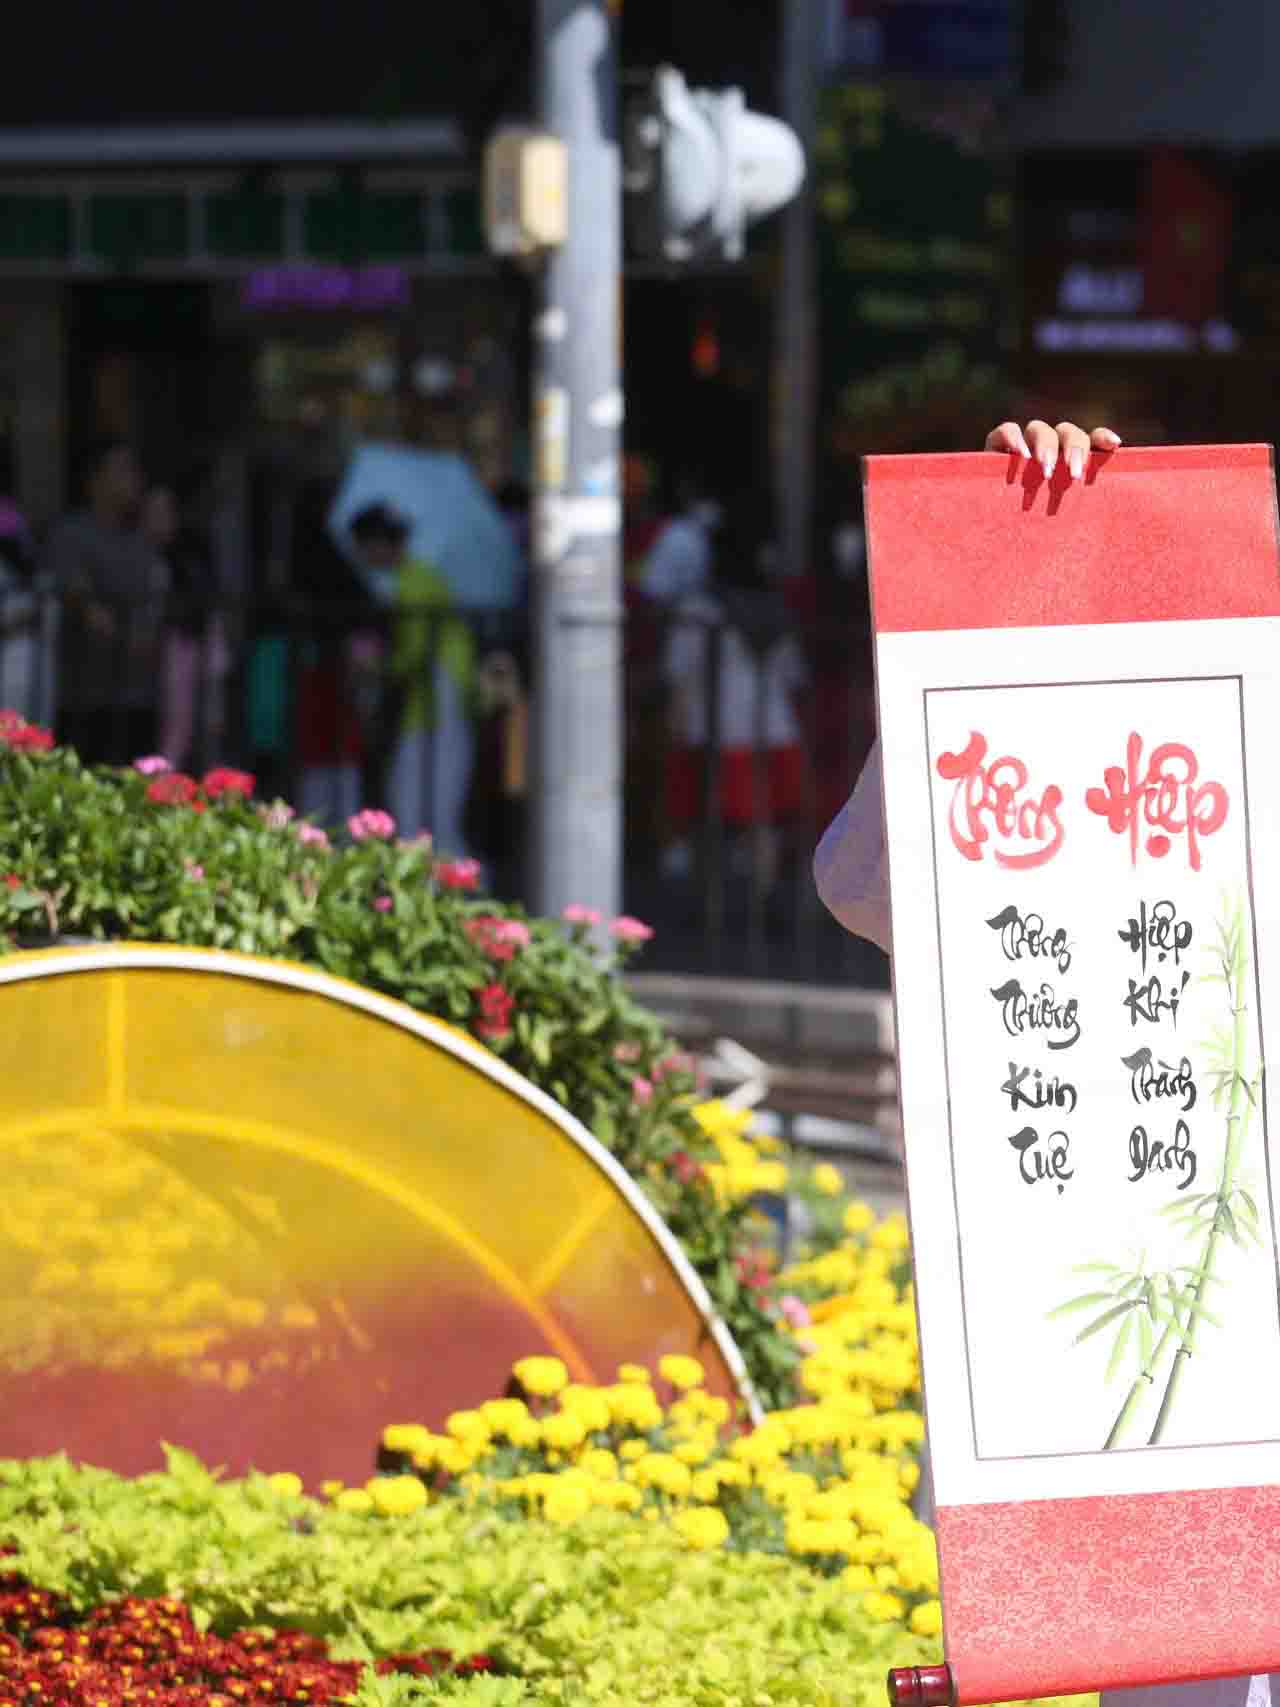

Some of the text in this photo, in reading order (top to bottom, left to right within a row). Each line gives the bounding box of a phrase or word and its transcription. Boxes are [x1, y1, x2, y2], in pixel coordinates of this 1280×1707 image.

[1085, 731, 1229, 871] Hiệp
[1001, 1062, 1078, 1113] Kim
[1118, 900, 1197, 1190] Hiệp Khí Thành Danh
[1008, 1127, 1075, 1195] Tuệ
